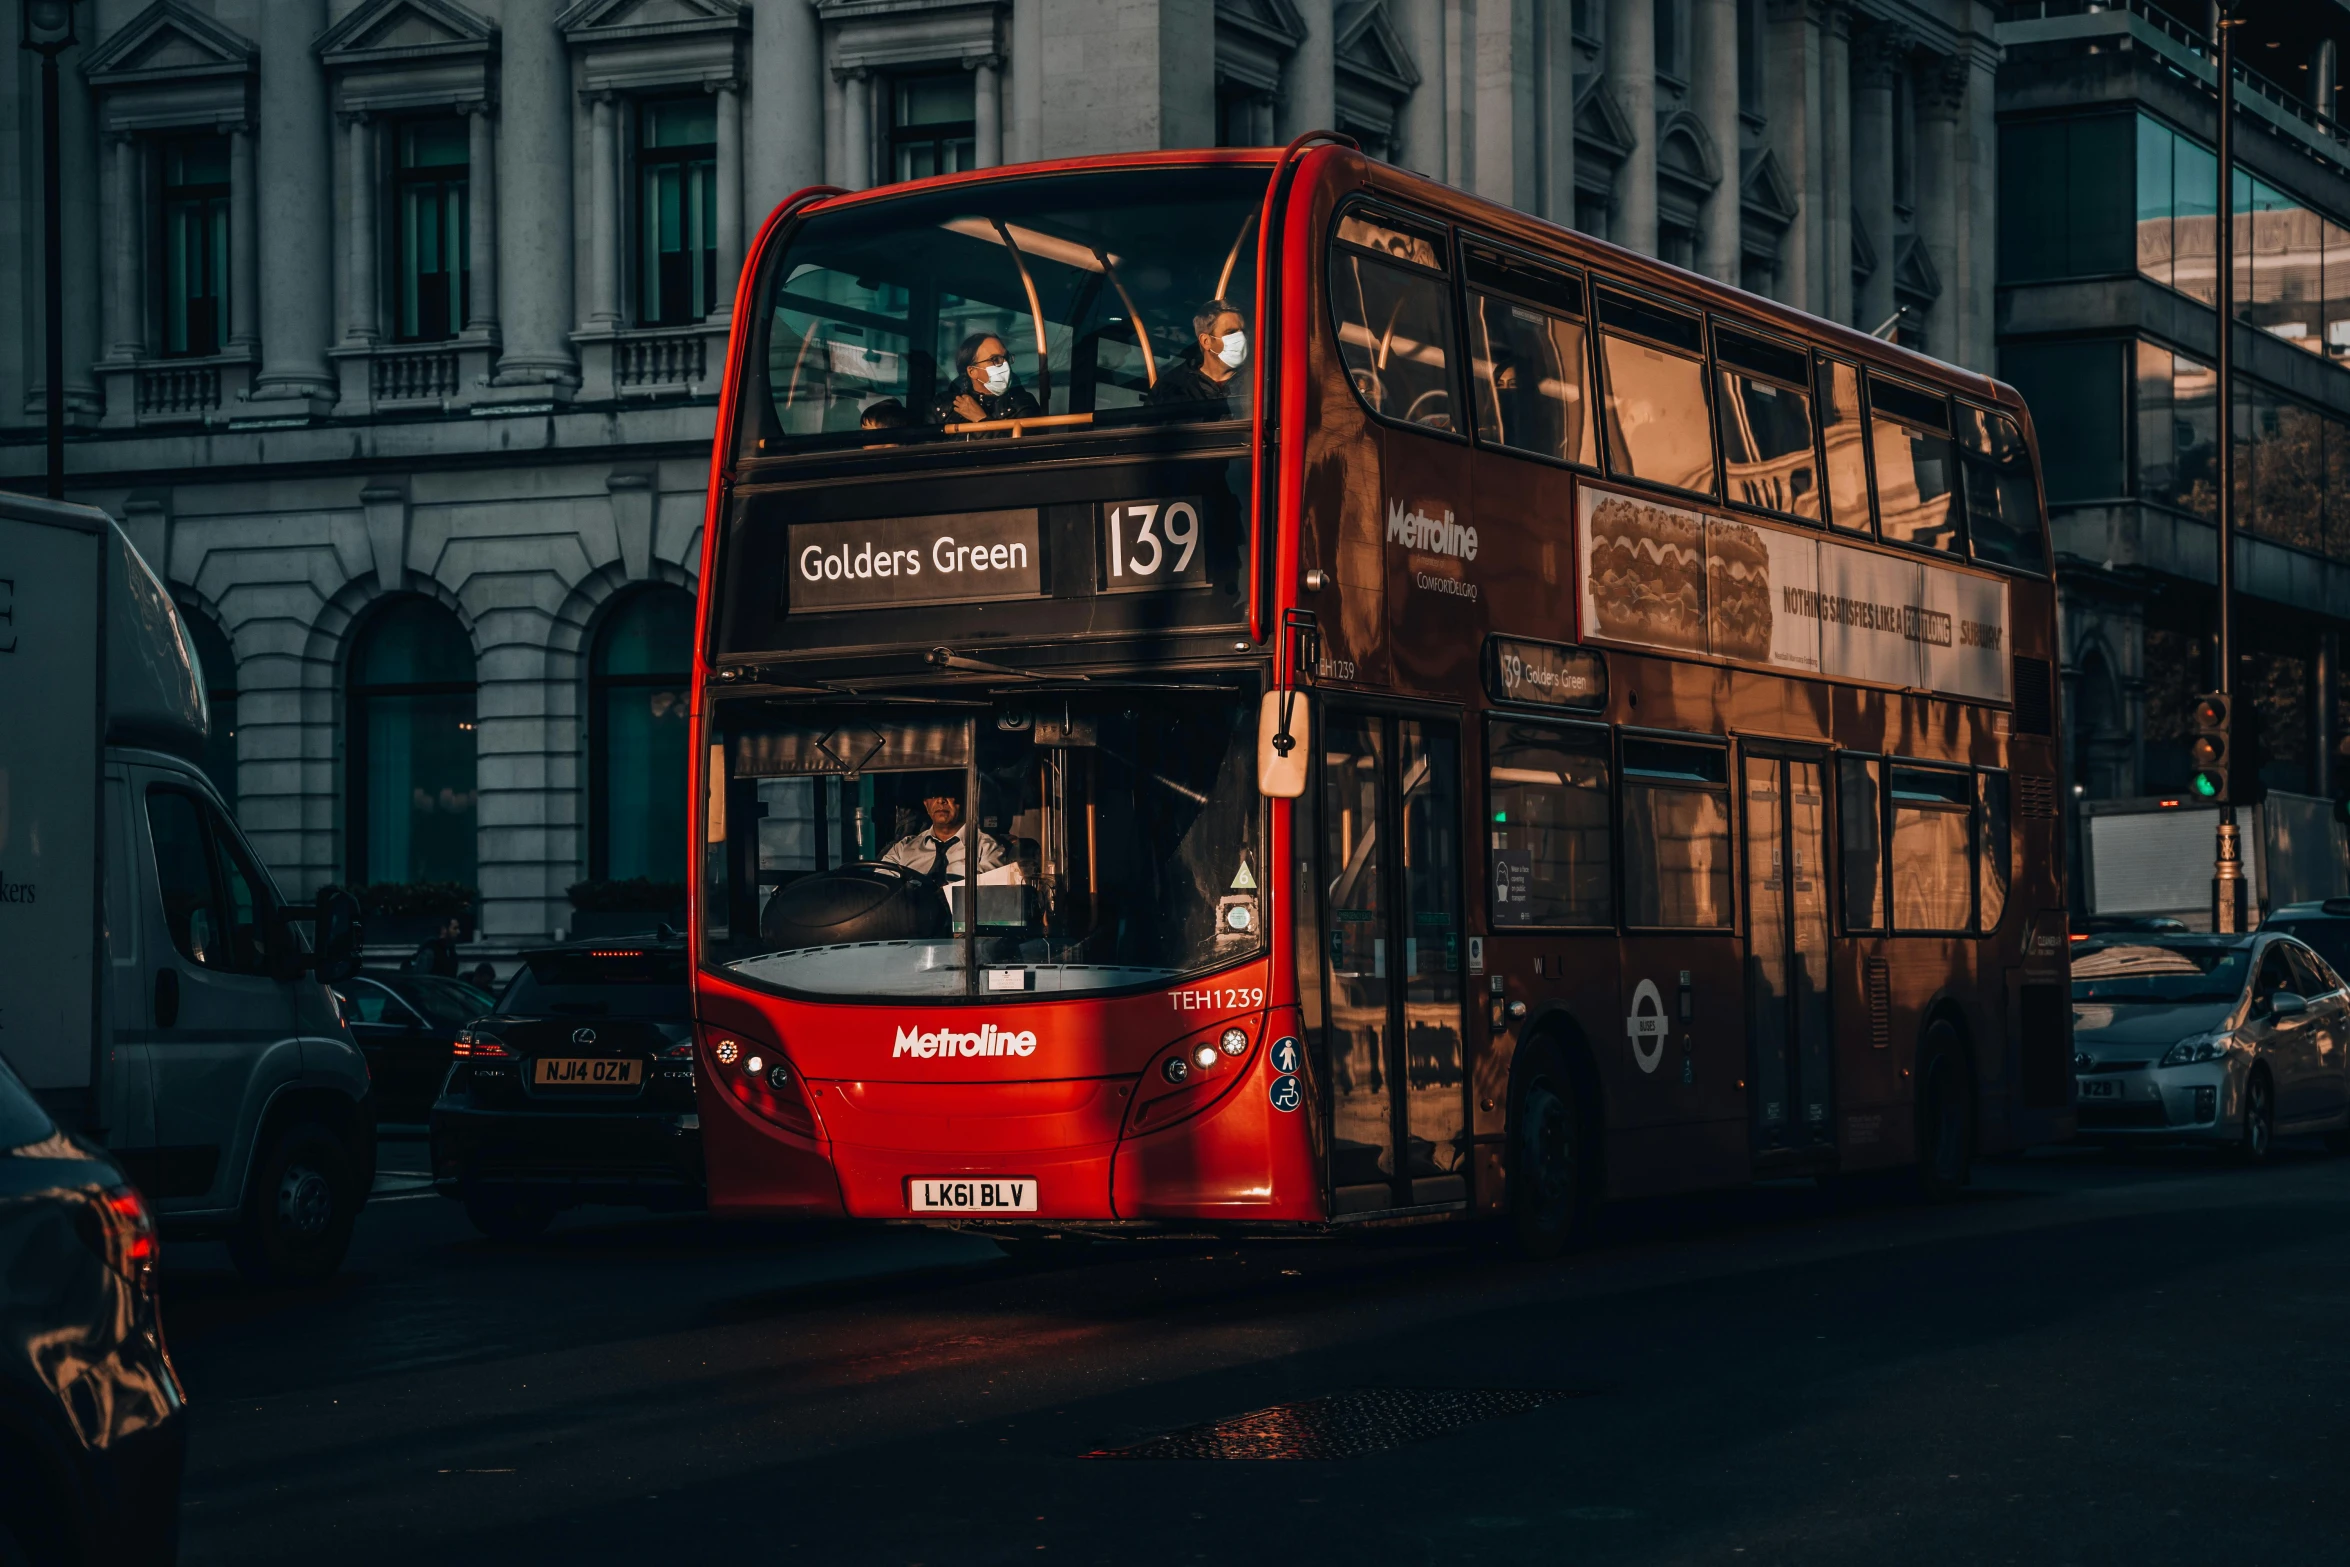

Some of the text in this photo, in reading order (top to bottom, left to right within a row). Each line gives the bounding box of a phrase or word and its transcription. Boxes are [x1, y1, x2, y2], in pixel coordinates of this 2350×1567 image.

[1110, 501, 1199, 577] 139
[1387, 497, 1478, 561] Metroline
[800, 536, 1028, 582] Golders Green
[1783, 586, 1829, 622] NOTHING
[1829, 596, 1874, 630] SATISFIES
[1875, 604, 1896, 632] LIKE
[1896, 608, 1903, 634] A
[1959, 619, 2003, 651] SUBWAY
[1525, 664, 1560, 687] Golders
[1561, 669, 1588, 690] Green
[1239, 869, 1249, 885] 6
[1168, 988, 1263, 1010] TEH1239
[1640, 1021, 1656, 1032] BUSES
[892, 1024, 1037, 1059] Metroline
[546, 1061, 631, 1081] NJ14 OZW
[925, 1184, 1023, 1206] LK61 BLV
